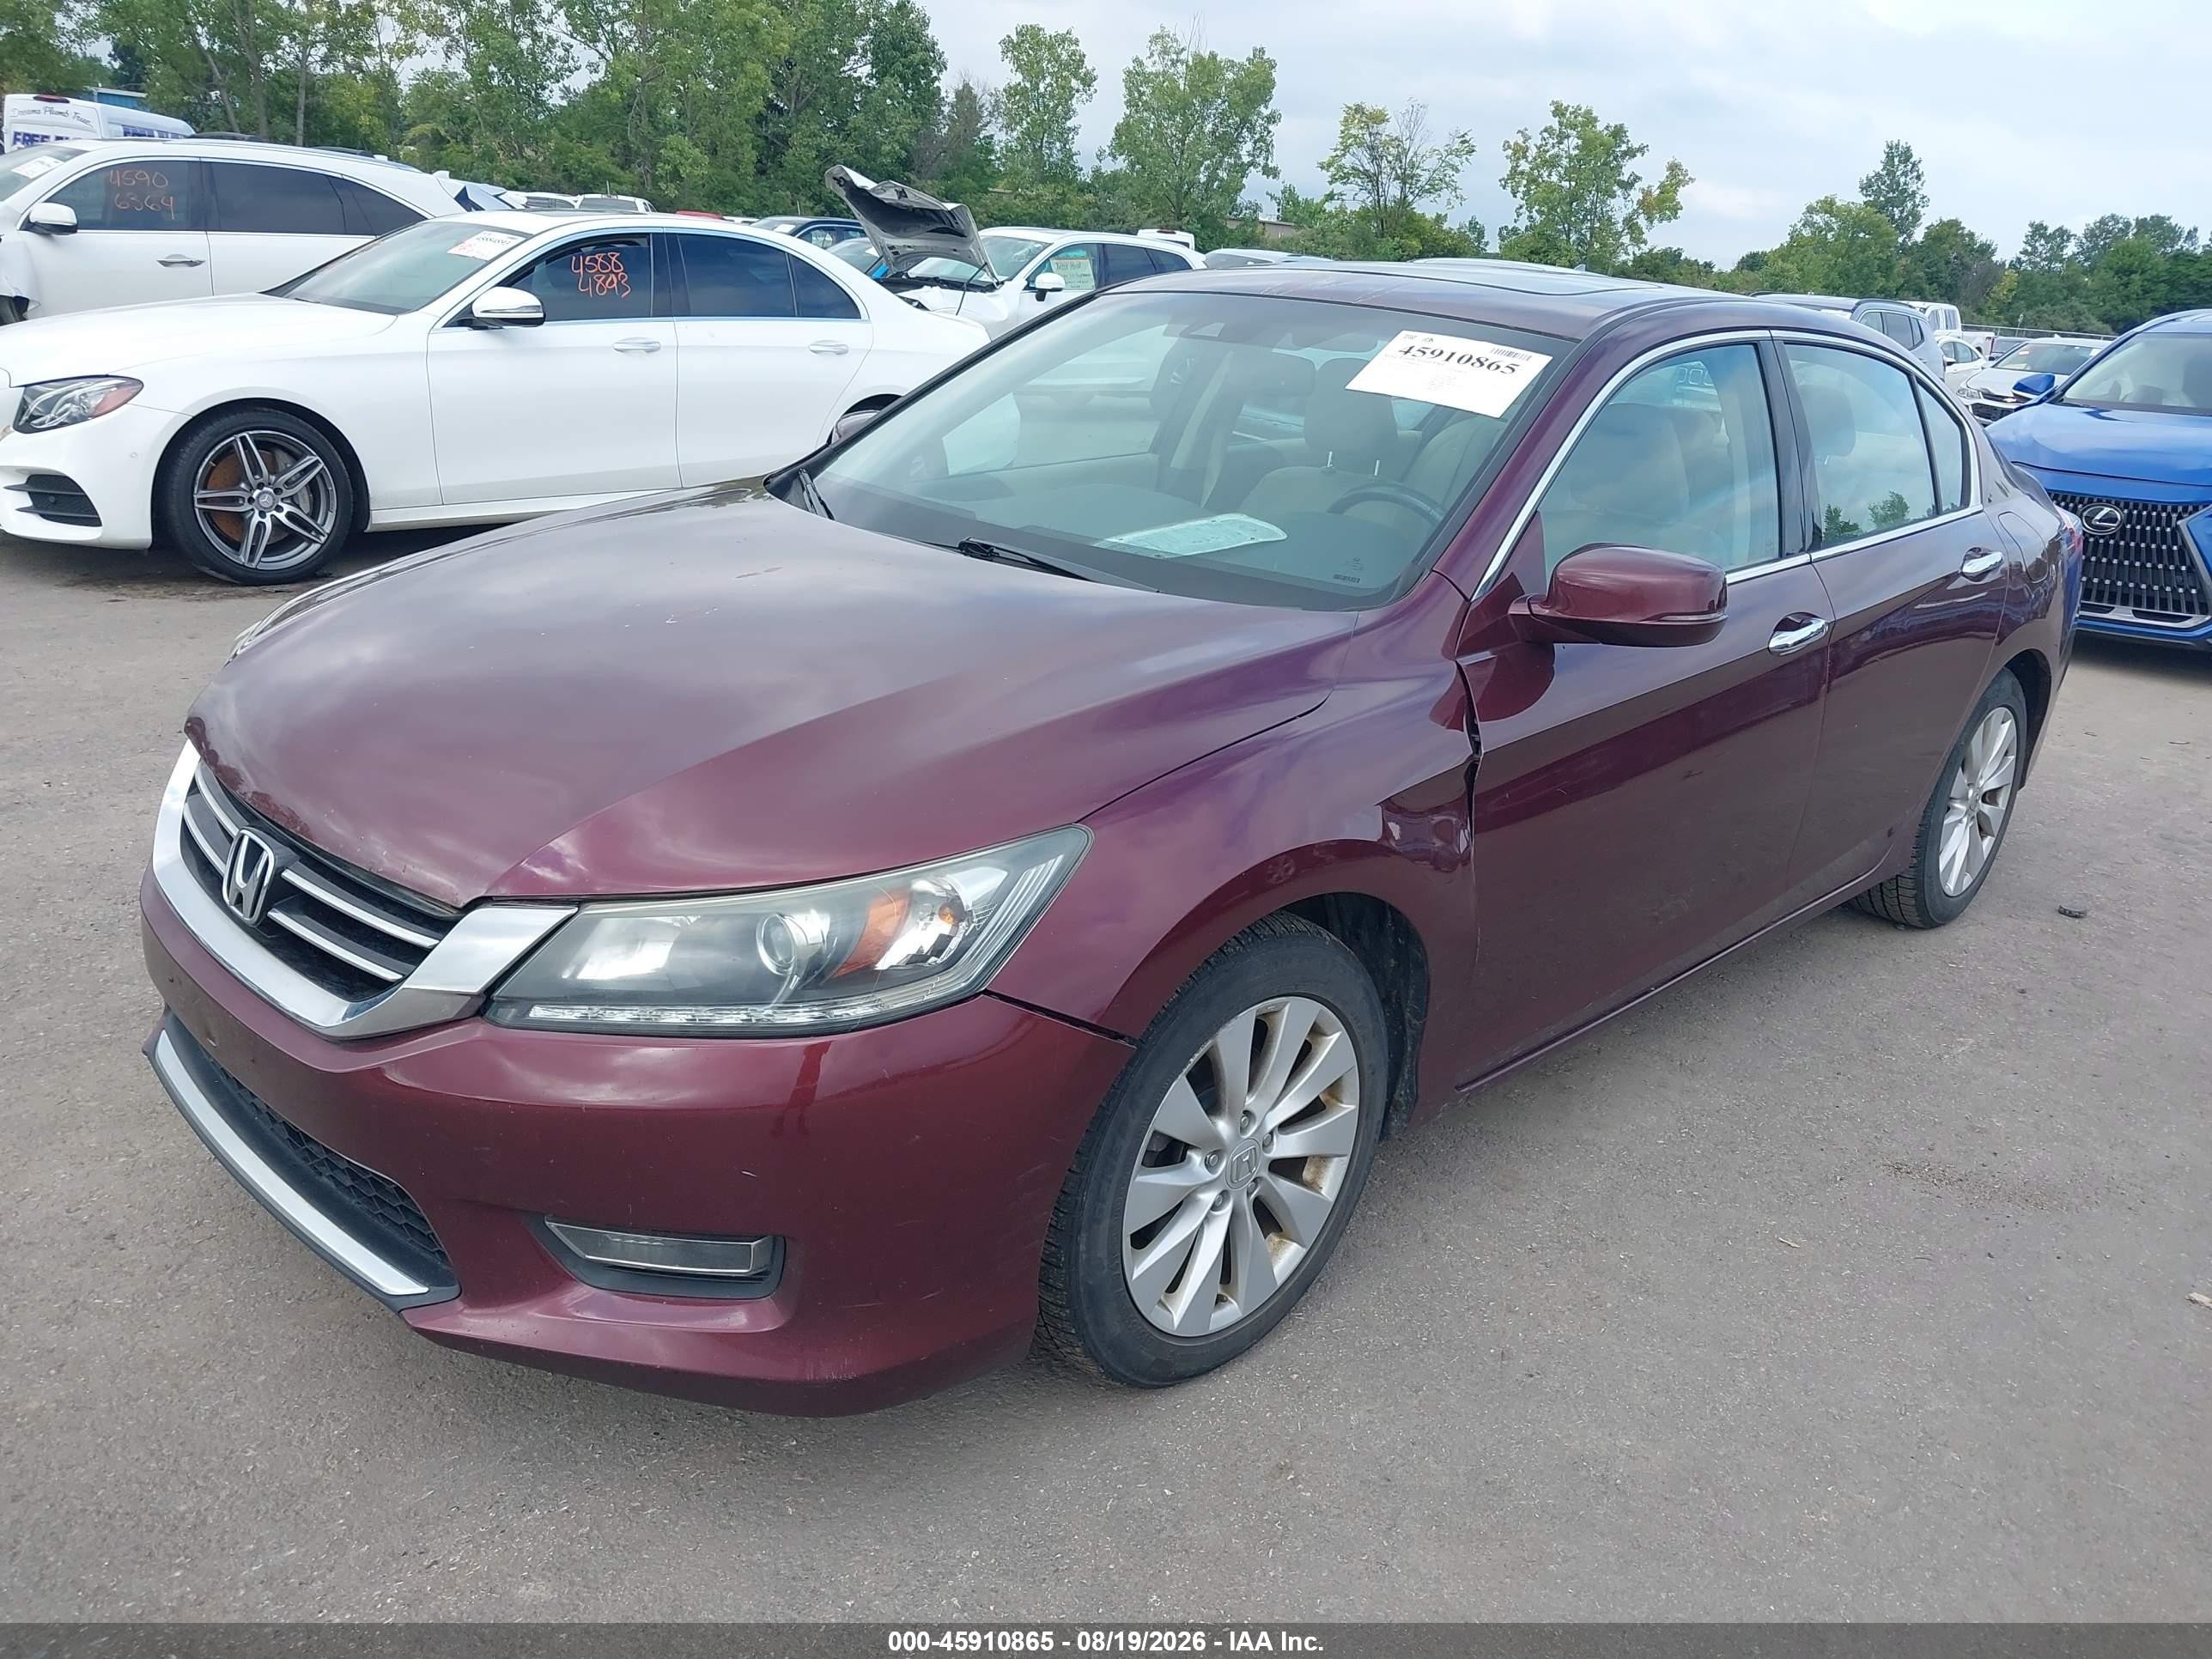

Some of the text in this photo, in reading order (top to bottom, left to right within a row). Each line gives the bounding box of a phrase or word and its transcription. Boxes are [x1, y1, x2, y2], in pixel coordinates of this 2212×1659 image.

[13, 131, 51, 147] FREE
[109, 169, 169, 188] 4590
[114, 191, 175, 221] 6364
[571, 252, 624, 274] 4588
[578, 271, 632, 299] 4893
[1398, 345, 1520, 375] 45910865
